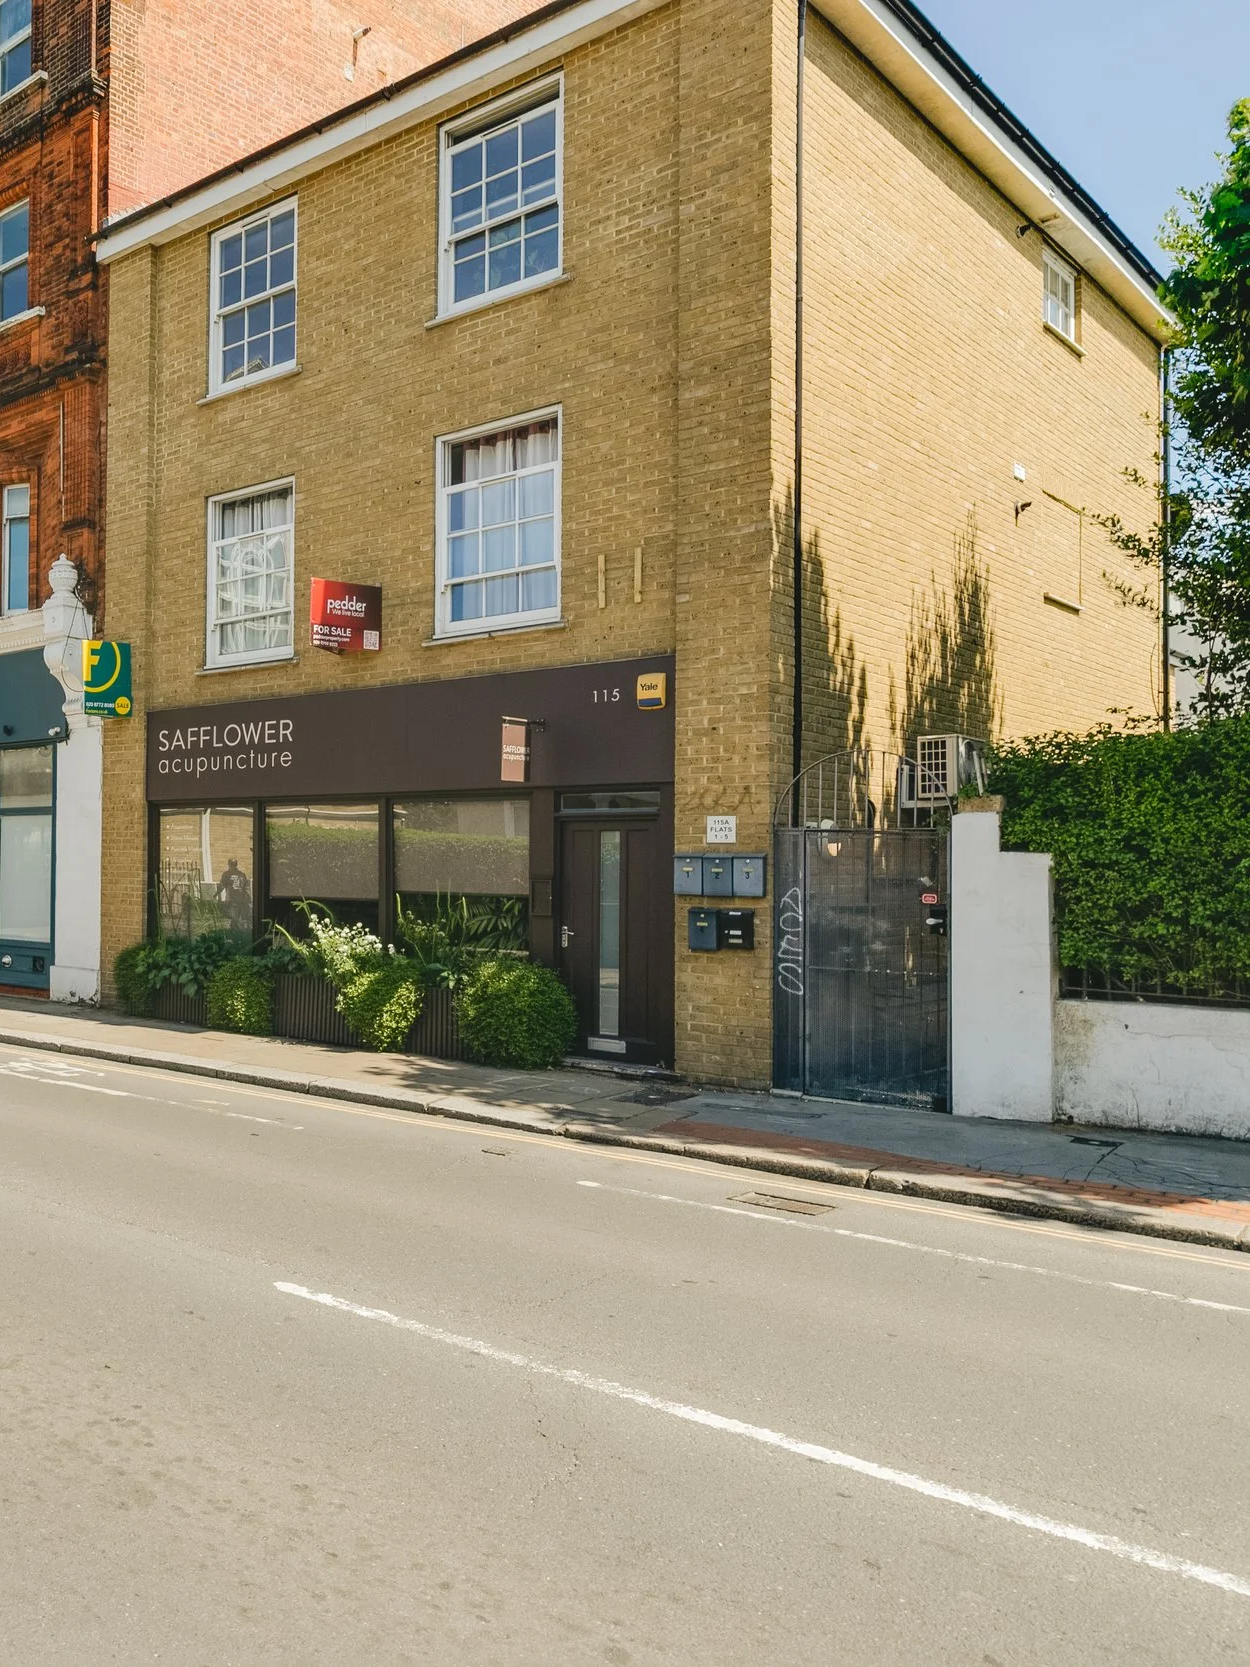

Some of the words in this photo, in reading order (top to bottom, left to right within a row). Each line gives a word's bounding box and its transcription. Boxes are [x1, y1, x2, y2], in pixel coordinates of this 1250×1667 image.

[327, 595, 367, 614] pedder
[342, 609, 351, 617] live
[313, 624, 330, 635] FOR
[331, 626, 352, 637] SALE
[640, 683, 658, 691] Yale
[593, 688, 620, 703] 115
[158, 719, 293, 752] SAFFLOWER
[158, 749, 292, 779] acupuncture
[745, 872, 750, 880] 3
